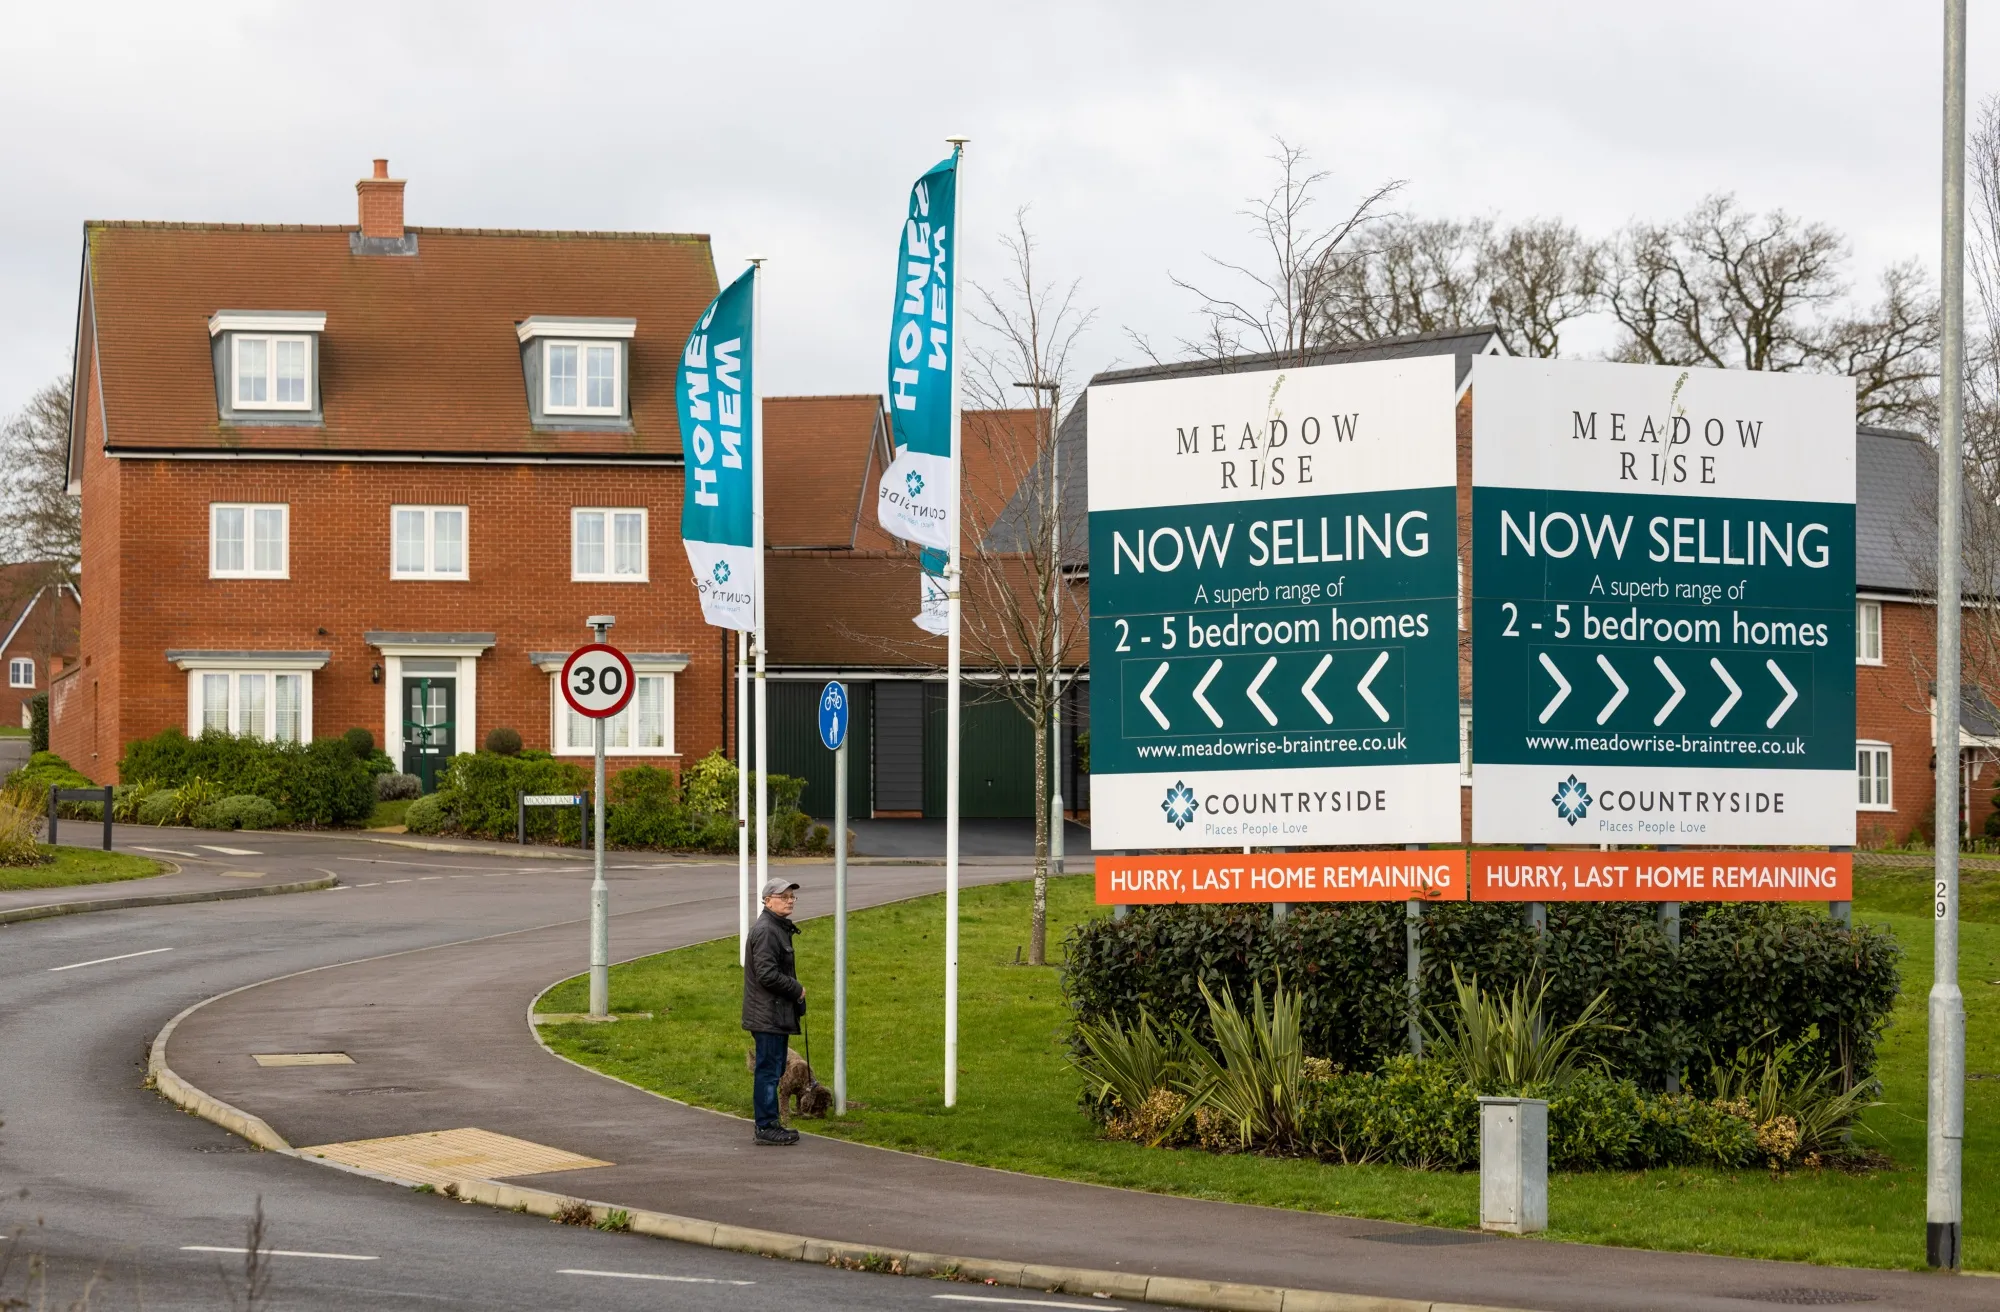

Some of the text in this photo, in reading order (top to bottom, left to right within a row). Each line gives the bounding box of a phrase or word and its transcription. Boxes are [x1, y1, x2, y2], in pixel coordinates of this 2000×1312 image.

[1176, 413, 1360, 455] MEADOW
[1572, 409, 1764, 449] MEADOW
[1220, 455, 1314, 490] RISE
[1619, 450, 1717, 485] RISE
[1113, 510, 1429, 575] NOW SELLING
[1501, 509, 1829, 569] NOW SELLING
[1194, 576, 1346, 609] A superb range of
[1589, 574, 1747, 605] A superb range of
[1115, 618, 1131, 652] 2
[1161, 616, 1177, 650] 5
[1188, 613, 1320, 649] bedroom
[1332, 607, 1429, 642] homes
[1502, 602, 1520, 637] 2
[1554, 604, 1571, 639] 5
[1584, 603, 1721, 643] bedroom
[1733, 610, 1829, 647] homes
[573, 666, 622, 695] 30
[1137, 735, 1407, 759] www.meadowrise-braintree.co.uk
[1525, 733, 1806, 754] www.meadowrise-braintree.co.uk
[555, 796, 573, 804] LANE
[1204, 790, 1386, 815] COUNTRYSIDE
[1599, 790, 1784, 813] COUNTRYSIDE
[1205, 822, 1308, 837] Places People Love
[1599, 819, 1706, 835] Places People Love
[1111, 865, 1450, 894] HURRY, LAST HOME REMAINING
[1487, 865, 1838, 891] HURRY, LAST HOME REMAINING
